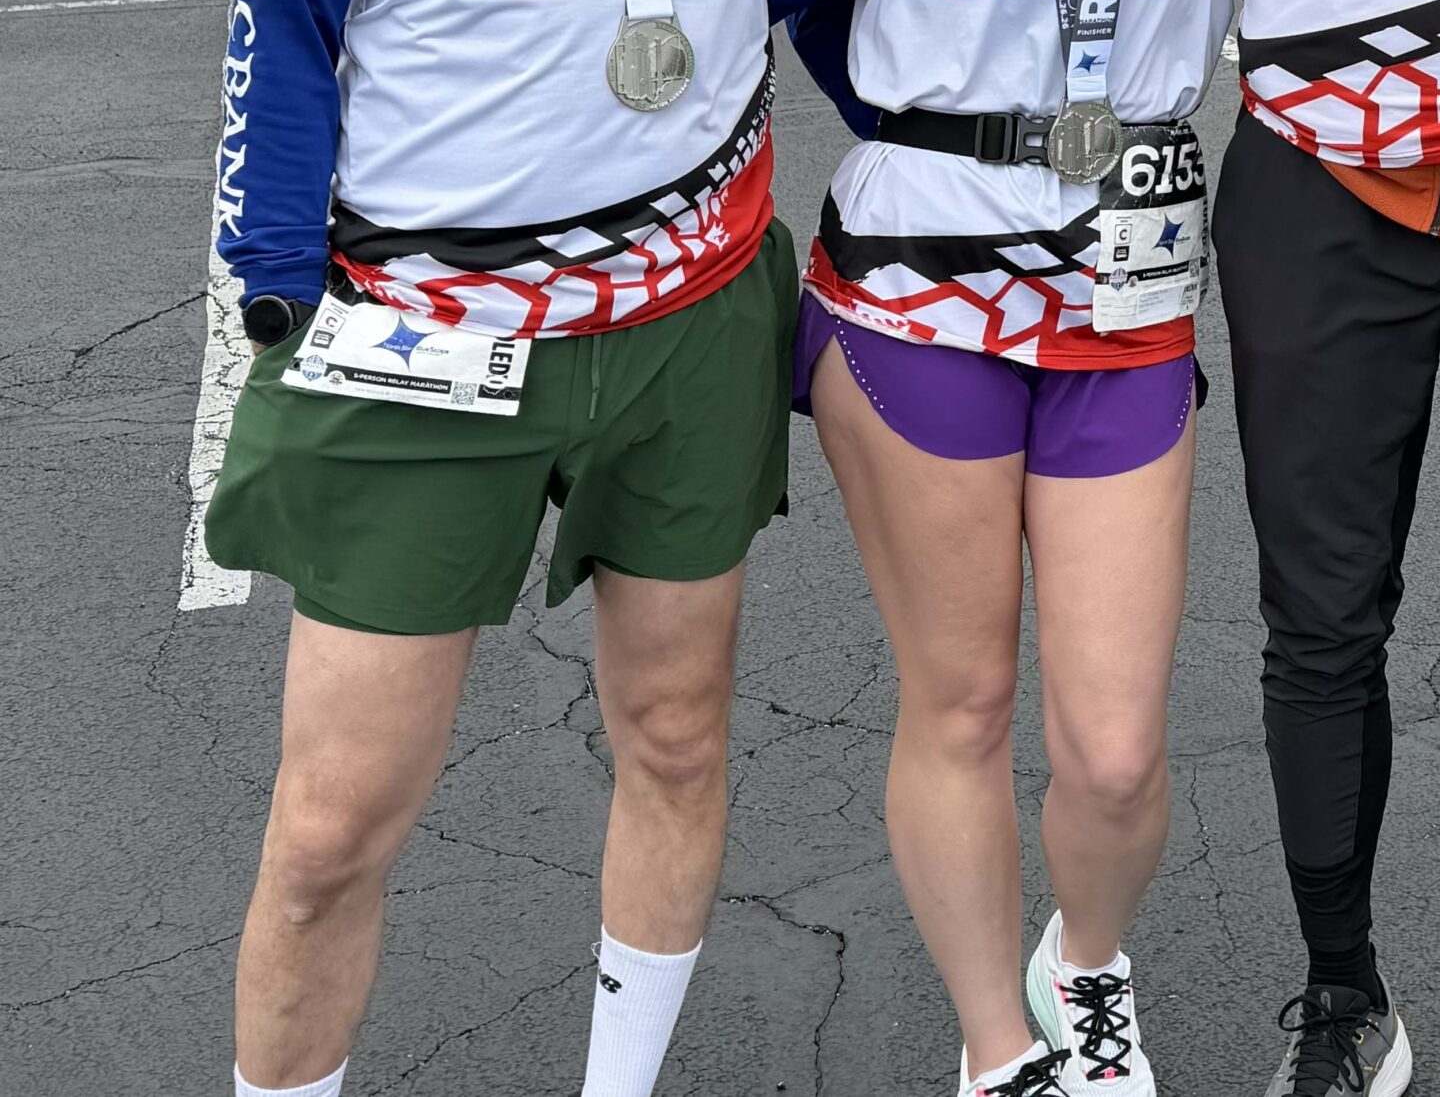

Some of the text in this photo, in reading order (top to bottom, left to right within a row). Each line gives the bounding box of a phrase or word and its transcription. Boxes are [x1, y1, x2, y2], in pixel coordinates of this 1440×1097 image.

[1077, 27, 1112, 36] FINISHER
[1119, 228, 1128, 241] C
[487, 338, 515, 388] LEDO
[353, 372, 449, 391] 5-PERSON RELAY MARATHON
